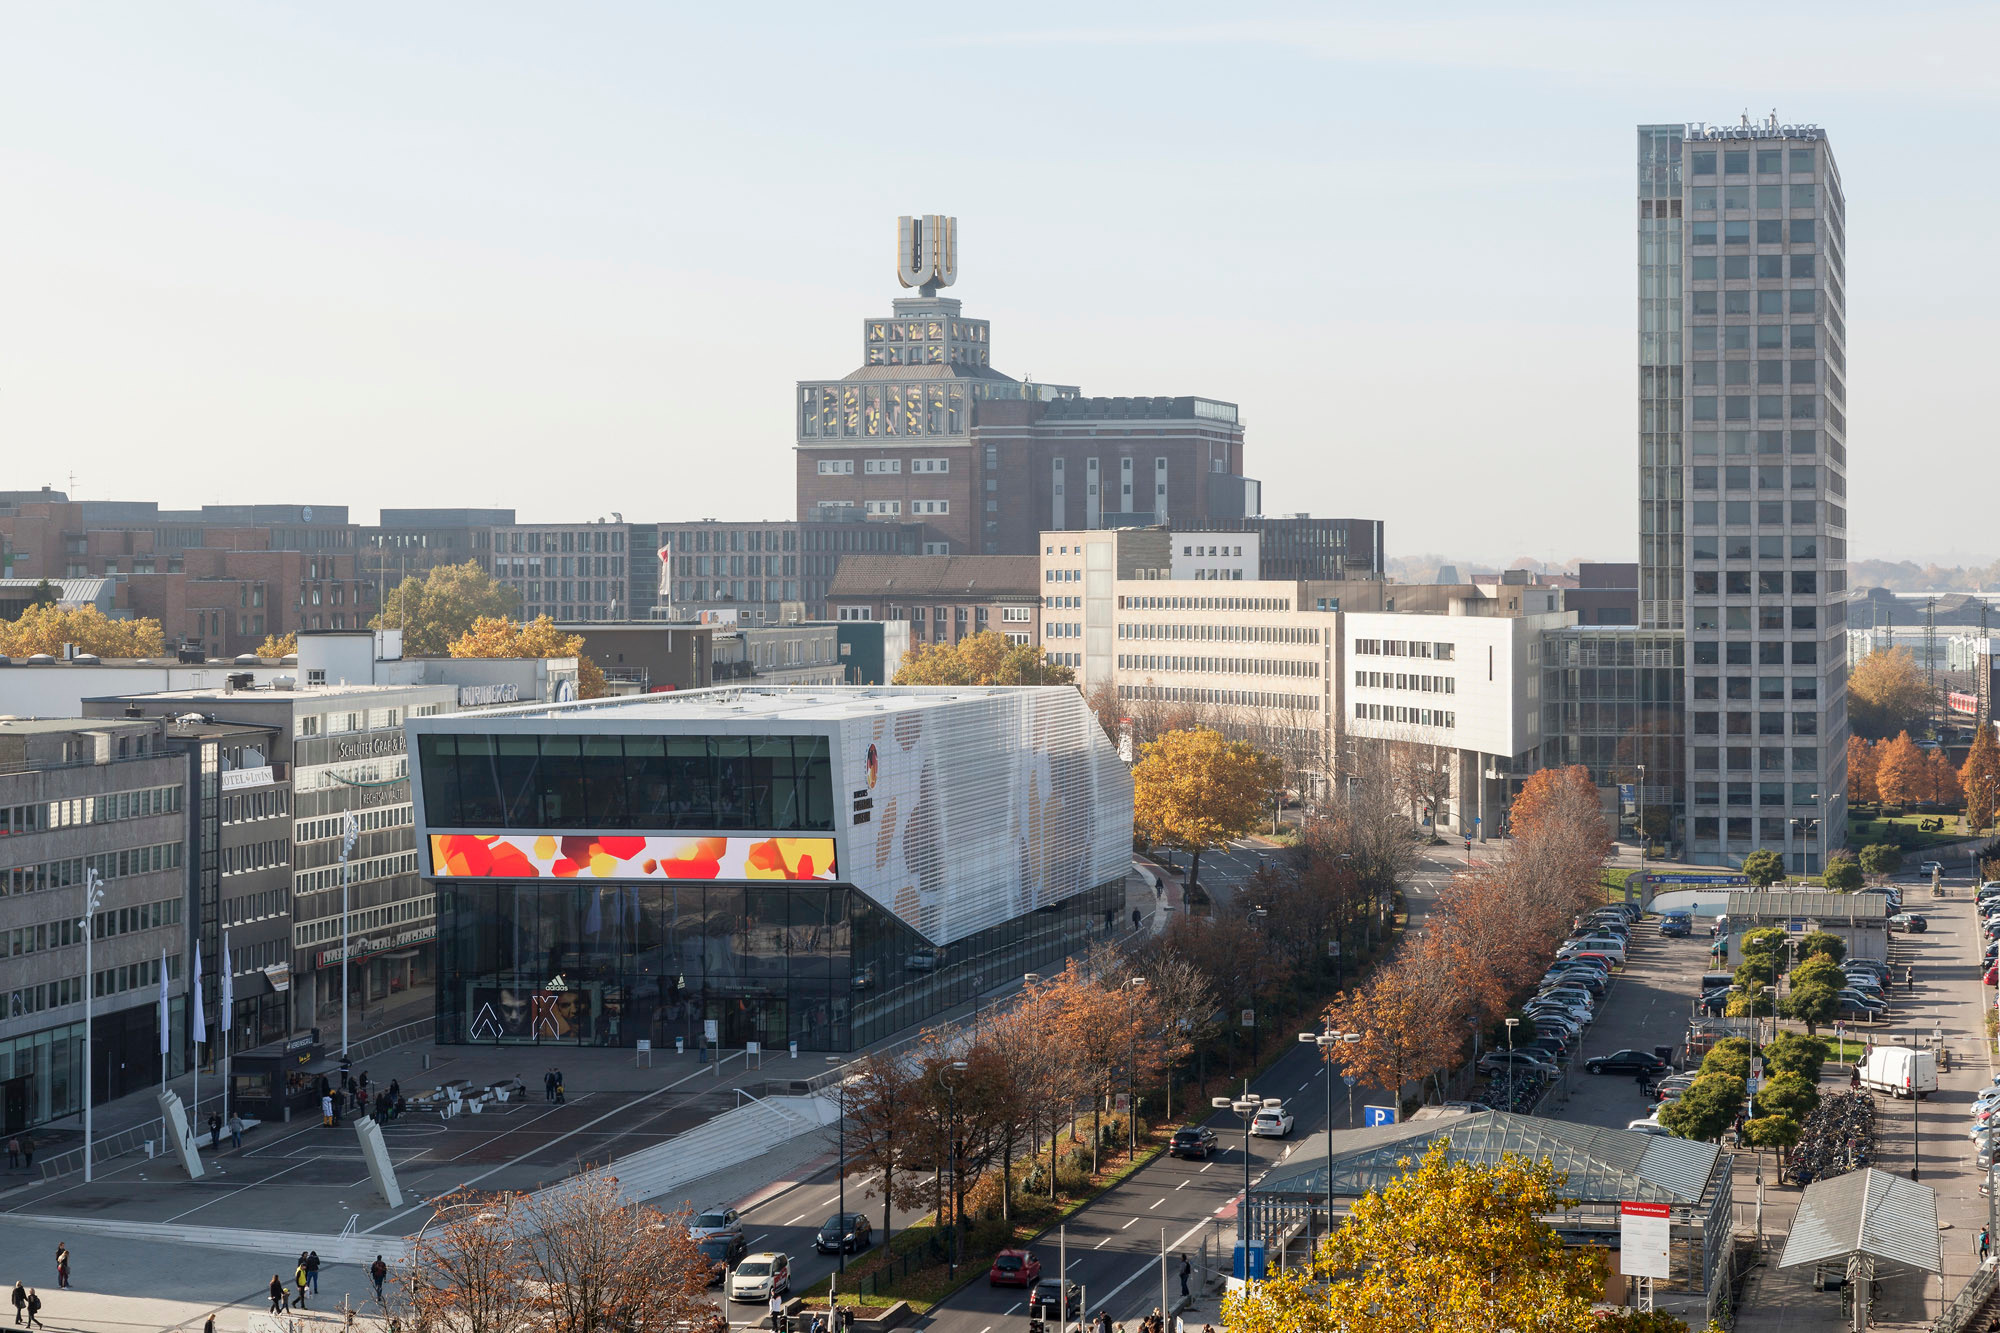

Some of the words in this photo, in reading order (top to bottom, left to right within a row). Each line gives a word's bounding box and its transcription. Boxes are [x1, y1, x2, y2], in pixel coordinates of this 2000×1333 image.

[1686, 118, 1818, 143] Harenberg
[374, 738, 391, 753] GRAF
[392, 738, 398, 751] &
[1375, 1109, 1386, 1127] P
